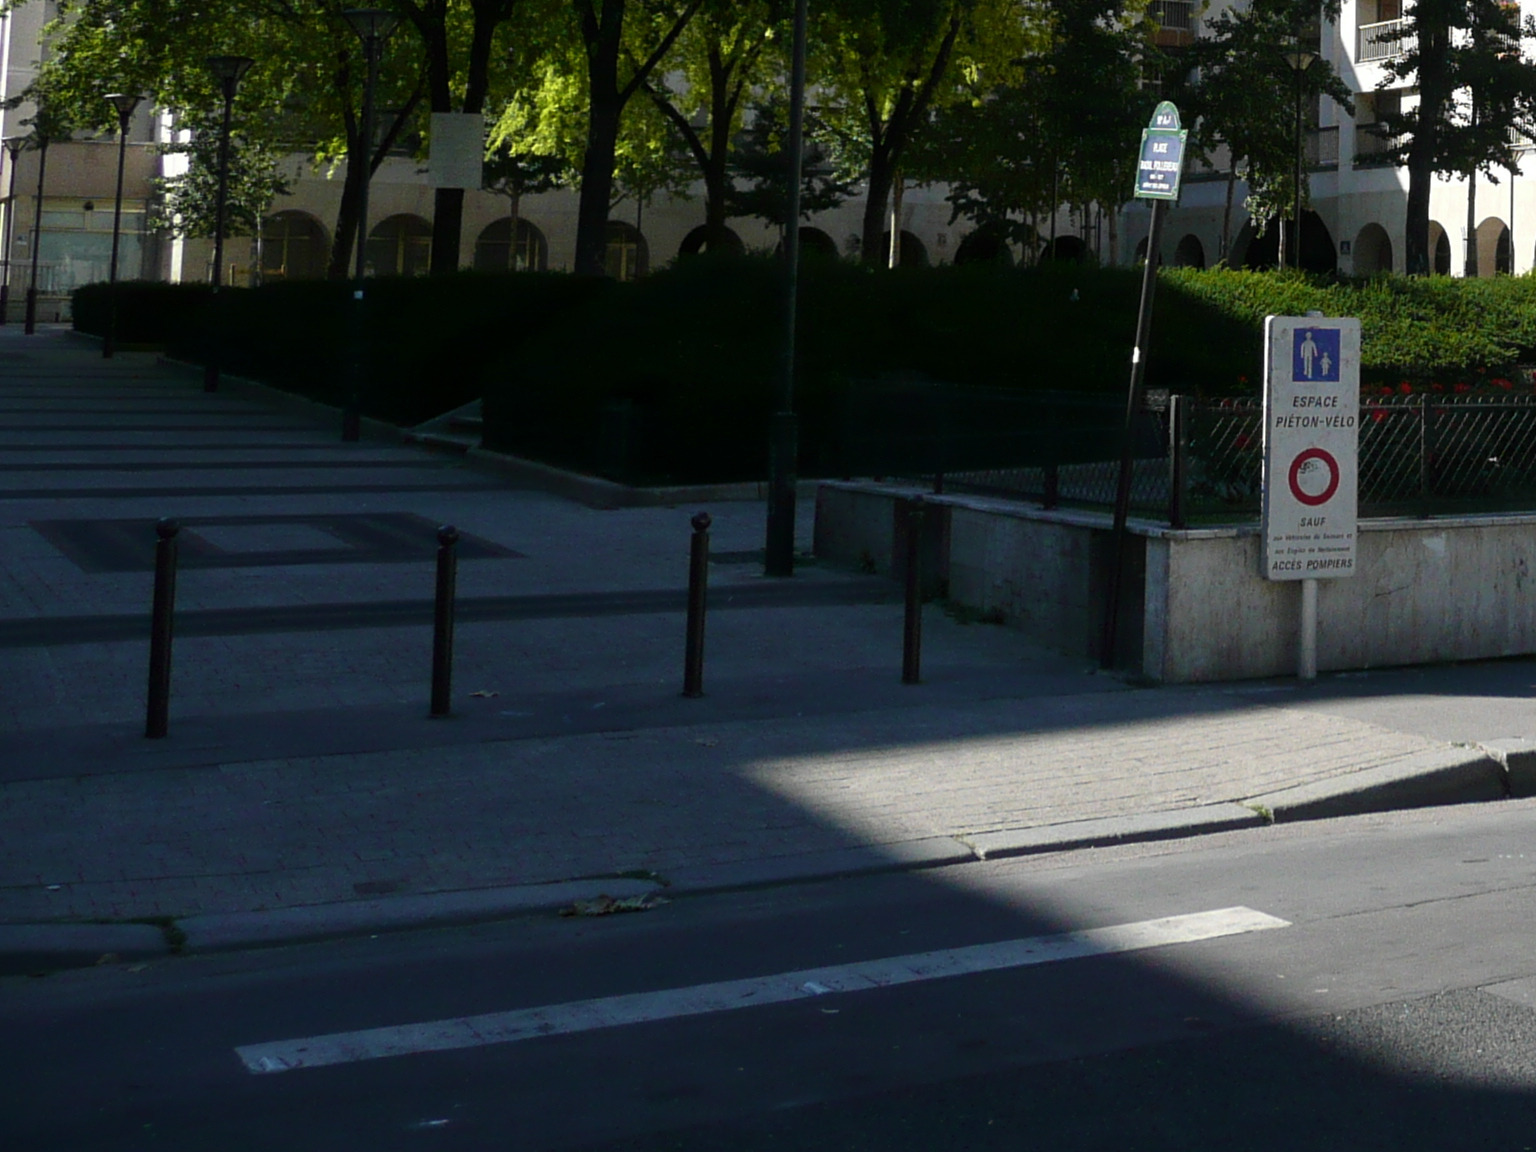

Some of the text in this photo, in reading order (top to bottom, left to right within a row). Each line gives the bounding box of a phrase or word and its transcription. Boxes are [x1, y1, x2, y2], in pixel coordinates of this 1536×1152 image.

[1292, 395, 1338, 408] ESPACE
[1300, 517, 1326, 527] SAUF
[1306, 559, 1353, 569] POMPIERS
